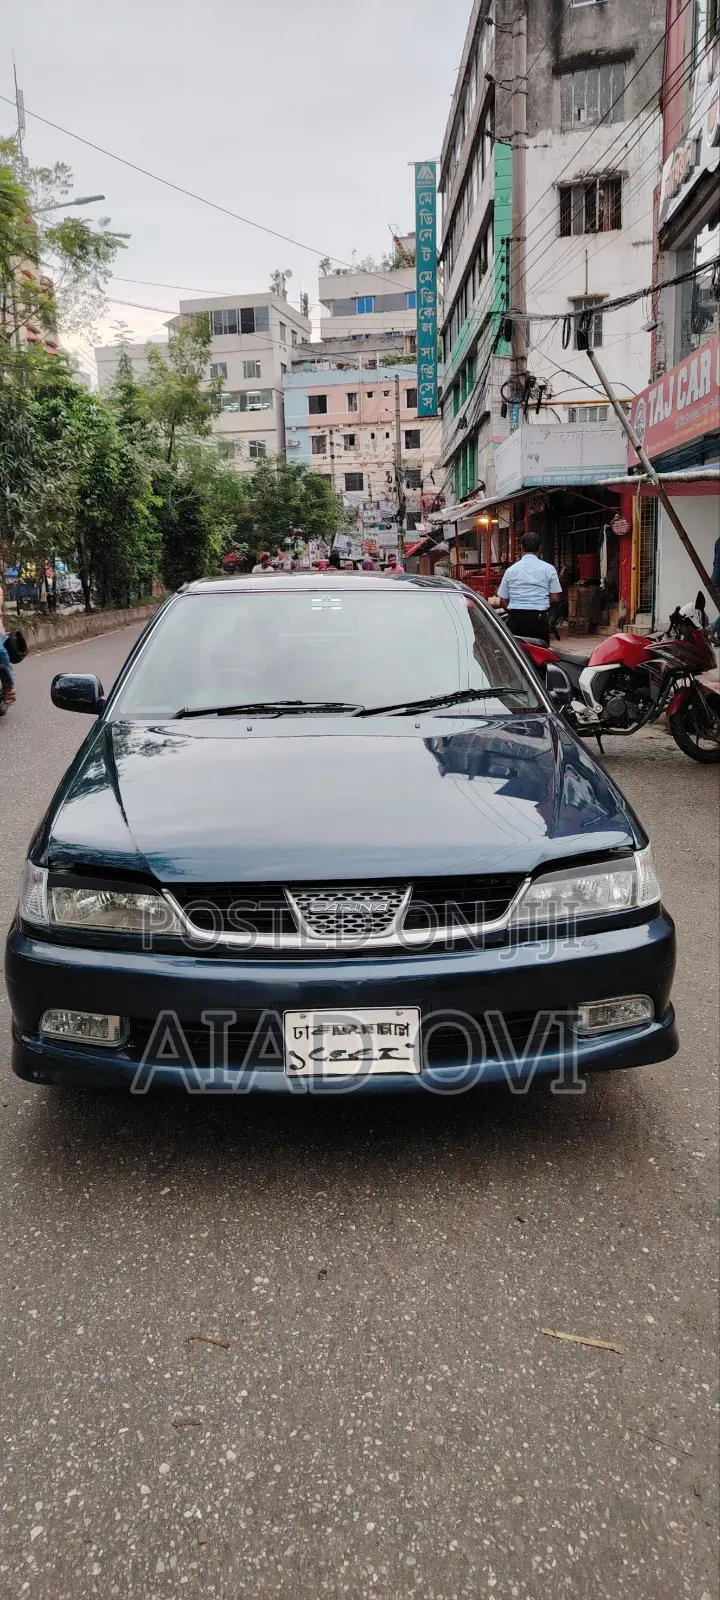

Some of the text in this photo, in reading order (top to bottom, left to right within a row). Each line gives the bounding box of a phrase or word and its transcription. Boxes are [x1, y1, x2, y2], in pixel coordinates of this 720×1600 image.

[419, 192, 434, 261] মেডিনেট
[419, 270, 435, 336] মেডিকেল
[648, 374, 674, 427] TAJ
[676, 347, 712, 411] CAR
[310, 902, 389, 913] CARINA
